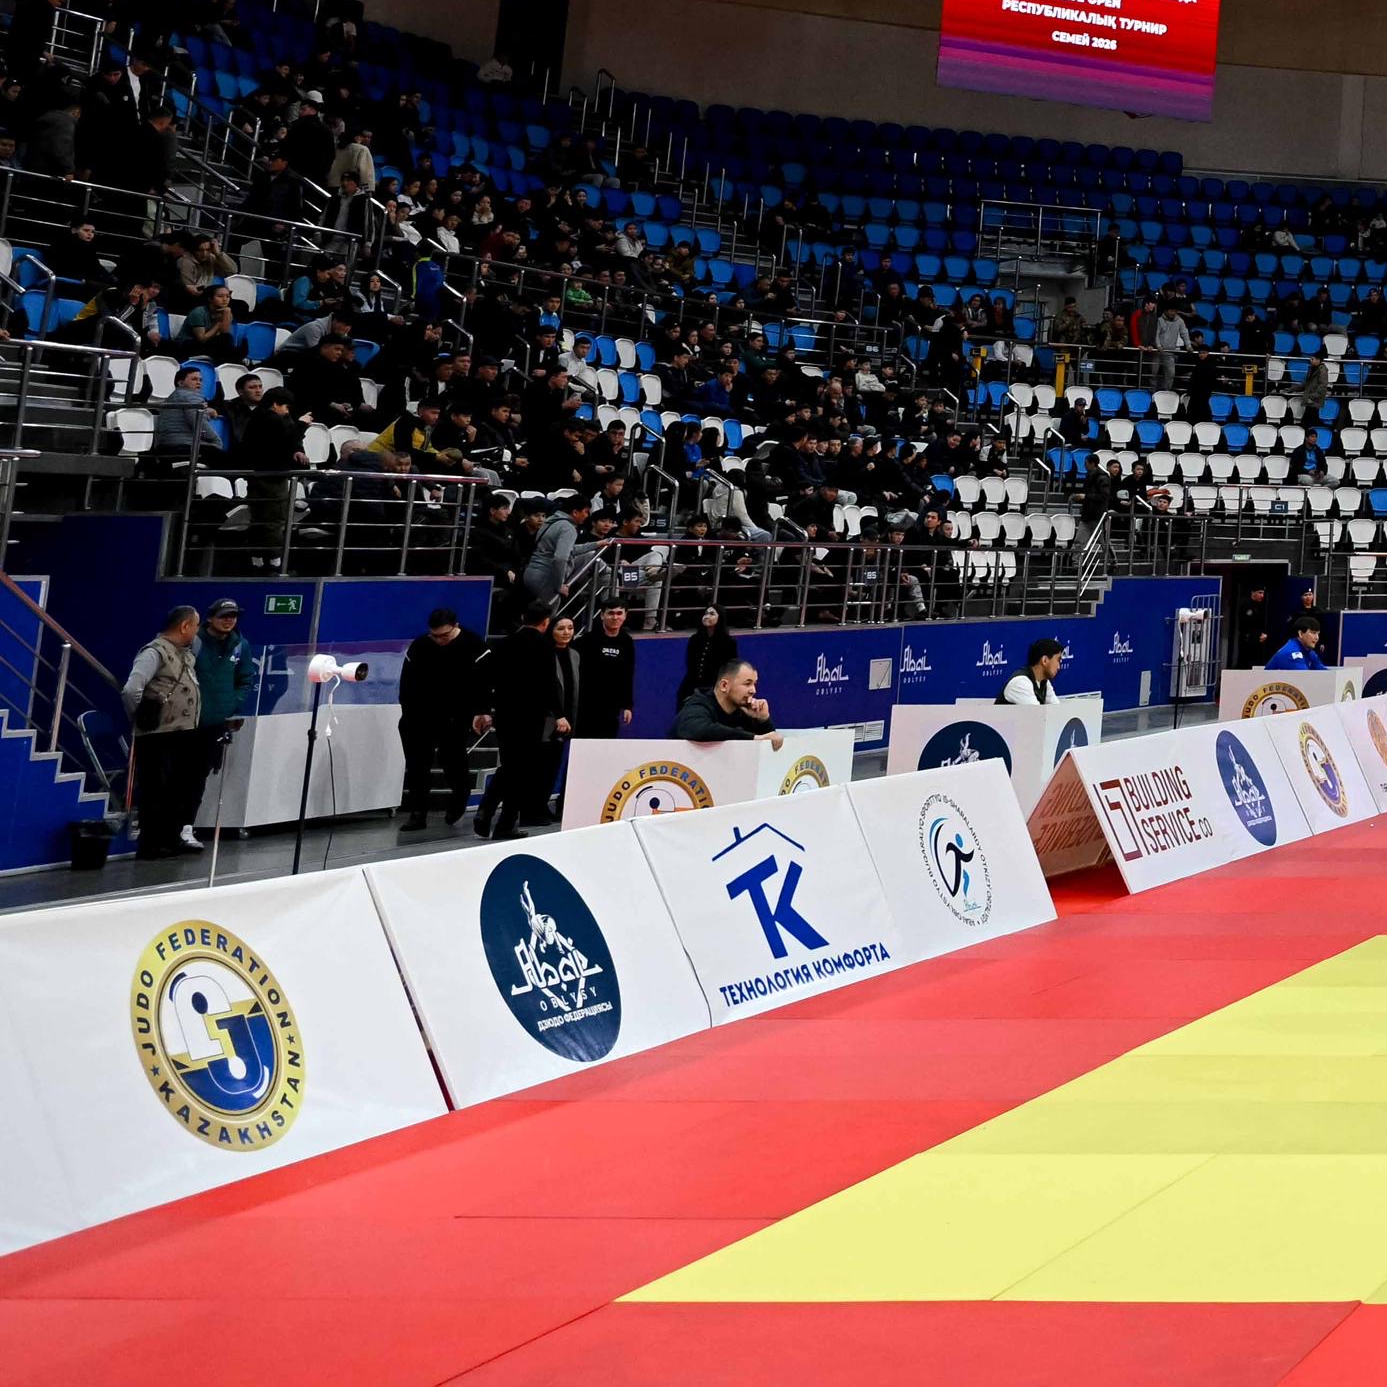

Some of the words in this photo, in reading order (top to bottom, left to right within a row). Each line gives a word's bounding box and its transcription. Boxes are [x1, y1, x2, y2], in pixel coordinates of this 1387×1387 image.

[1052, 30, 1090, 47] СЕМЕЙ
[1119, 17, 1168, 35] ТУРНИР
[1124, 766, 1192, 812] BUILDING
[1141, 807, 1202, 854] SERVICE
[136, 970, 158, 1056] JUDO
[155, 927, 293, 1029] FEDERATION
[719, 963, 814, 1007] ТЕХНОЛОГИЯ
[812, 942, 890, 979] КОМФОРТА
[537, 1014, 565, 1032] ДЗЮДО
[158, 1050, 300, 1145] KAZAKHSTAN
